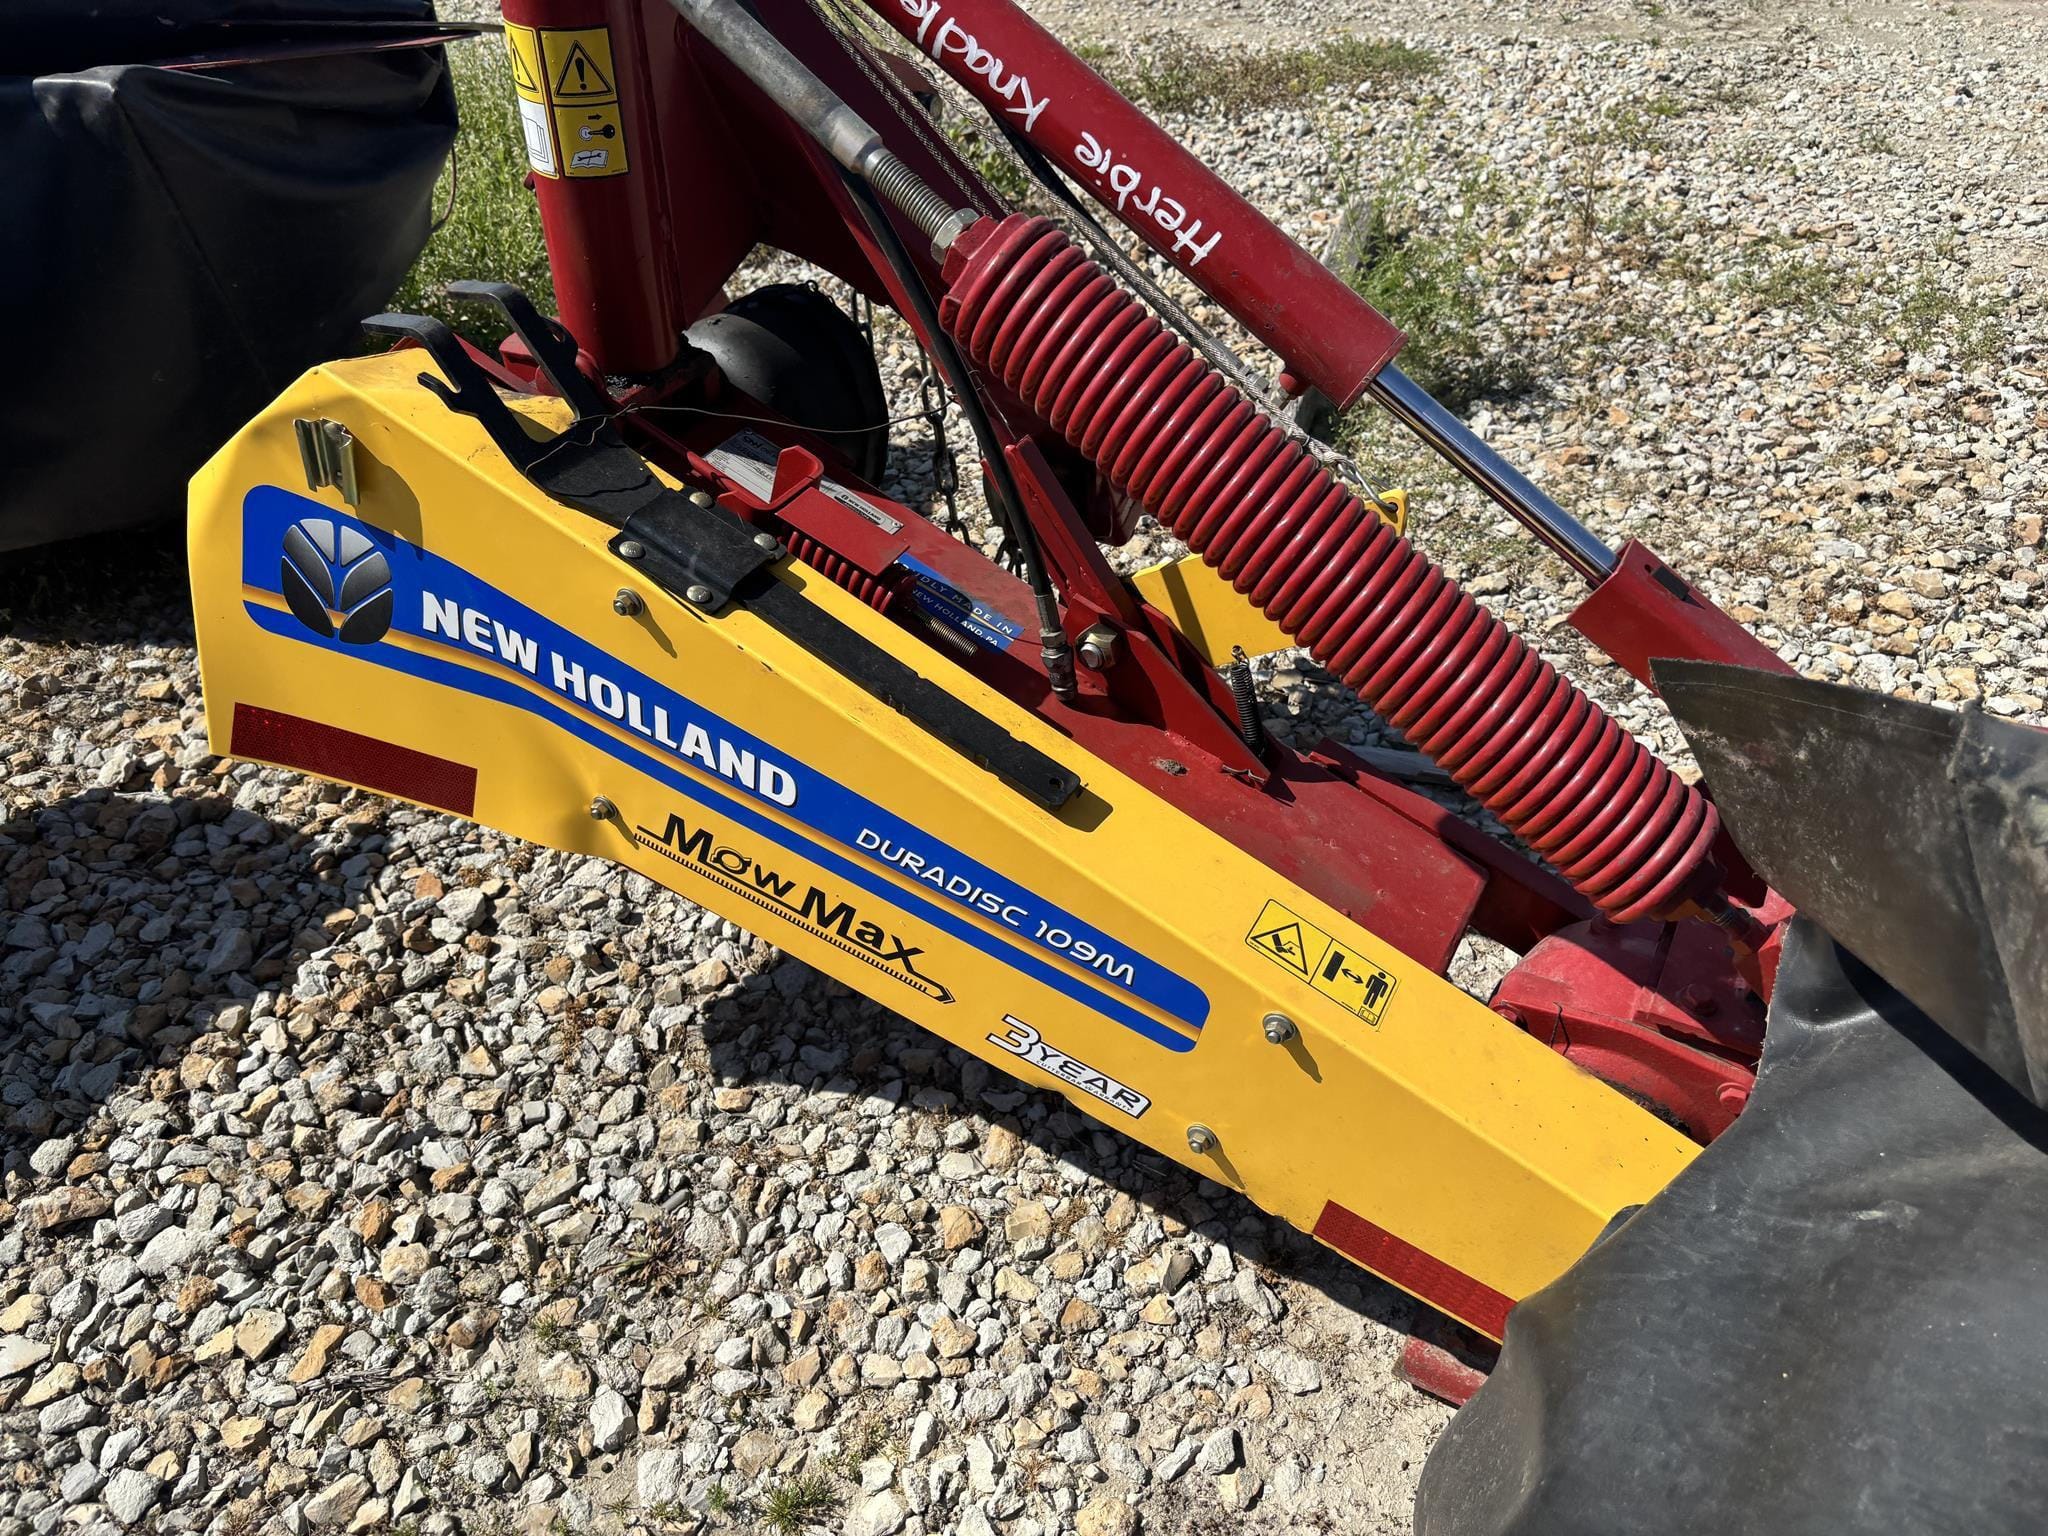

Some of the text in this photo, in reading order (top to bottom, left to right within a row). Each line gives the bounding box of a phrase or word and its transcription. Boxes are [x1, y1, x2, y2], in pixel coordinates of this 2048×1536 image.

[1073, 131, 1222, 266] Herbie
[951, 594, 992, 621] MADE
[996, 621, 1013, 635] IN
[986, 635, 999, 647] PA
[422, 590, 798, 808] NEW HOLLAND
[855, 828, 1136, 987] DURADISC 109M
